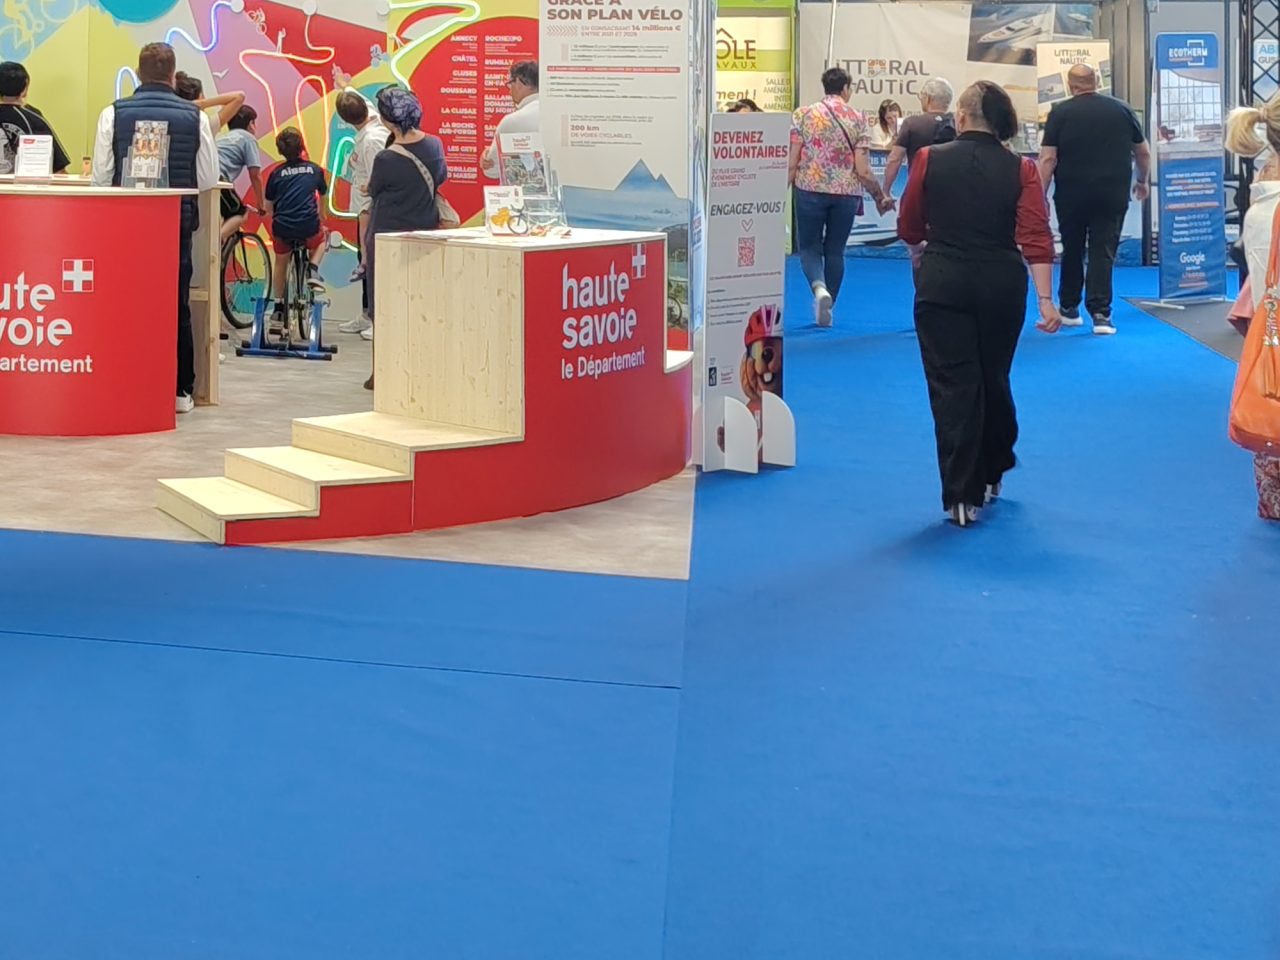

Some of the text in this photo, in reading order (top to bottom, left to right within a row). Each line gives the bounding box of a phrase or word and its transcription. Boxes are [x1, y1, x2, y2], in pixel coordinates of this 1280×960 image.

[547, 5, 683, 21] SON PLAN VÉLO
[1169, 46, 1208, 58] ECOTHERM
[713, 131, 764, 144] DEVENEZ
[713, 145, 788, 159] VOLONTAIRES
[710, 201, 786, 217] ENGAGEZ-VOUS !
[1179, 251, 1206, 264] Google
[561, 260, 630, 310] haute
[562, 307, 637, 349] savoie
[561, 346, 646, 379] le Département
